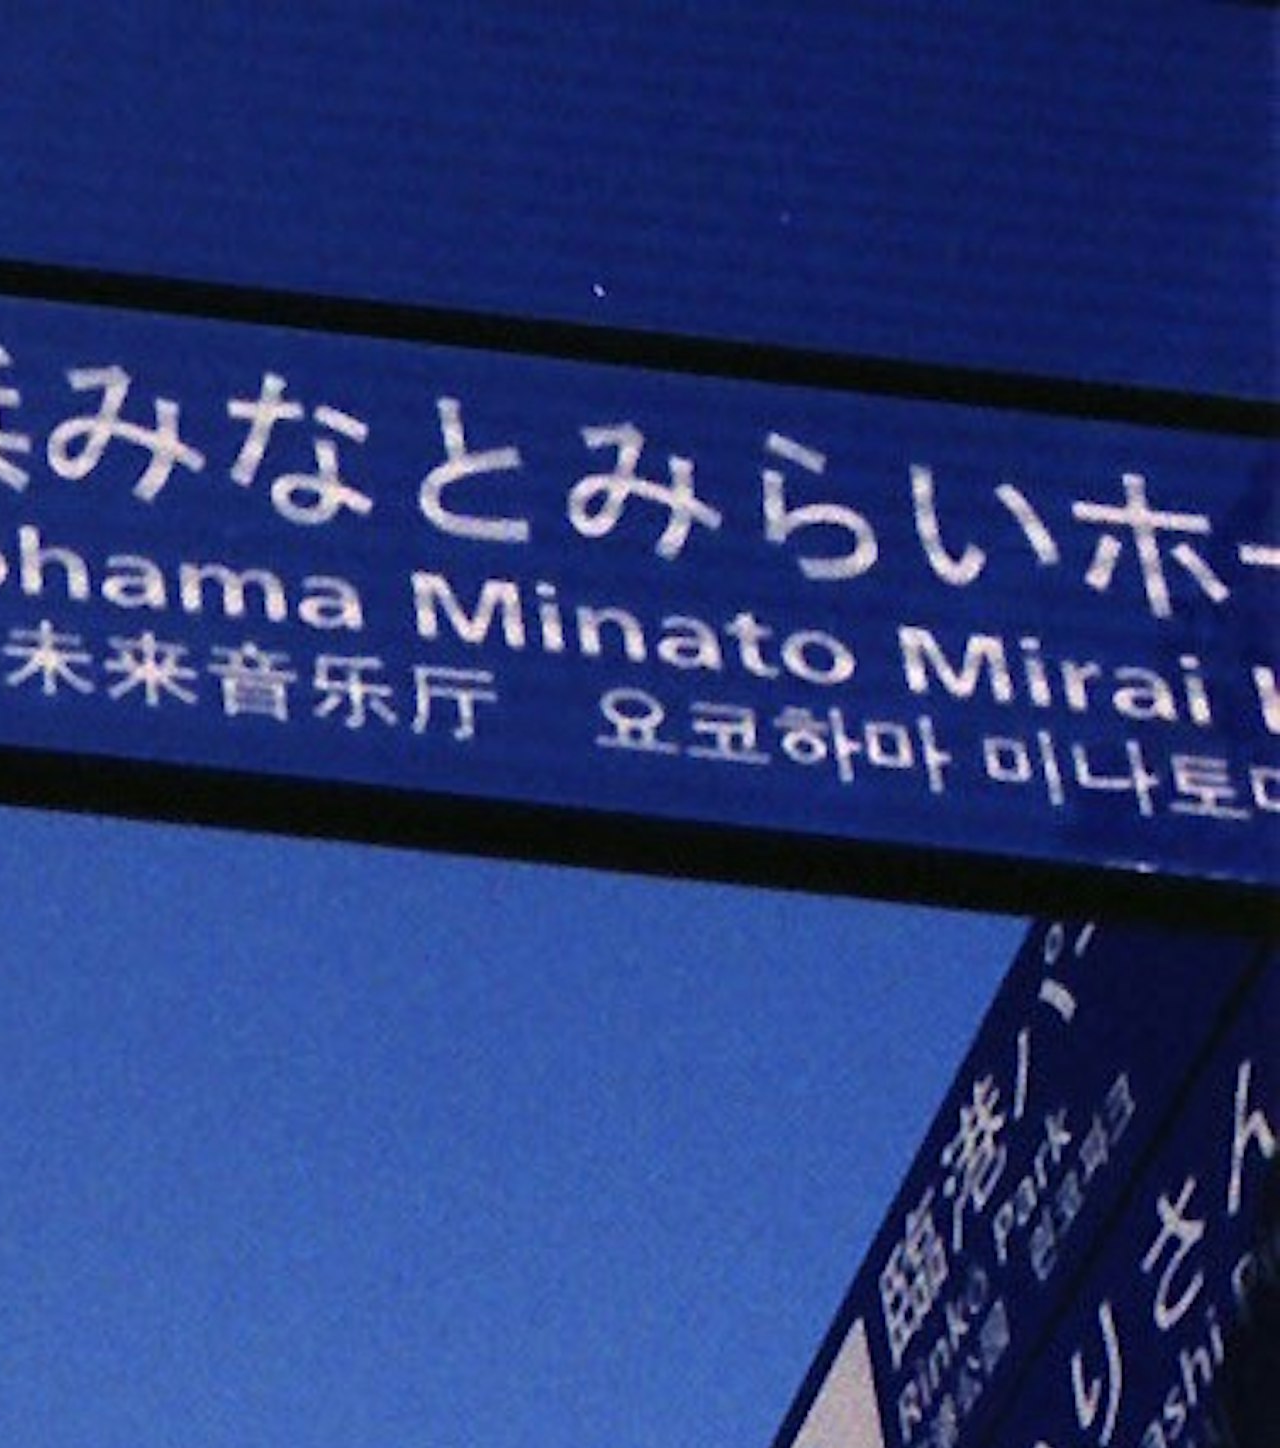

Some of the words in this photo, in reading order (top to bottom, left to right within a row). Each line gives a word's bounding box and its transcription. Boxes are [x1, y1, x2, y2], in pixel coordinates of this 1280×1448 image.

[413, 568, 856, 687] Minato
[897, 623, 1213, 726] Mirai
[597, 687, 951, 796] 요코하마
[878, 920, 1097, 1369] 臨港パ
[992, 1107, 1073, 1263] Park
